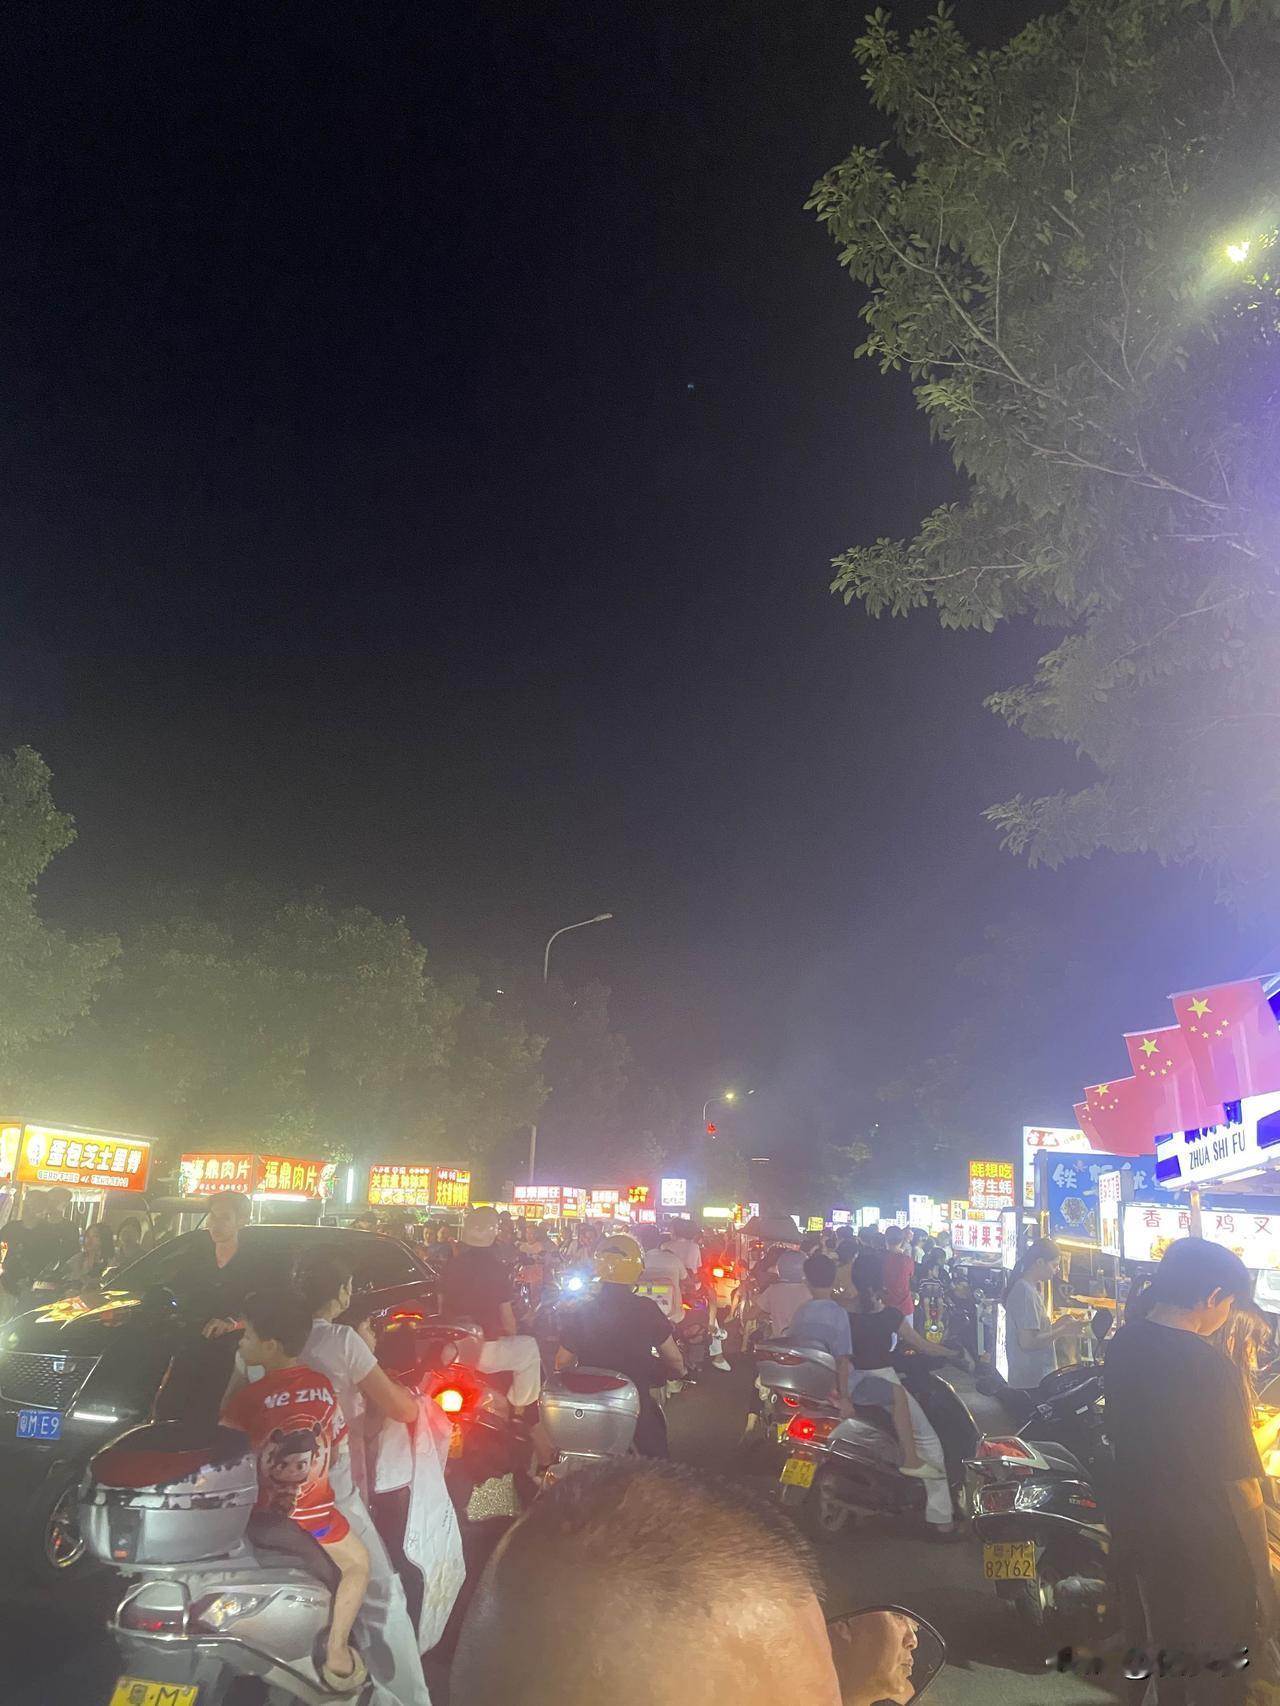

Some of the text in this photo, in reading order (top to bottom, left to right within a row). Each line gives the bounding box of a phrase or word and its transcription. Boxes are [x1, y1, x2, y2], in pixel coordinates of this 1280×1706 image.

[1189, 1130, 1246, 1170] ZHUA SHI FU
[265, 1160, 318, 1192] 福鼎肉片
[971, 1162, 1013, 1179] 蚝想吃
[971, 1178, 1013, 1194] 烤生蚝
[295, 1387, 334, 1406] ZHA
[985, 1560, 1031, 1578] 82Y62
